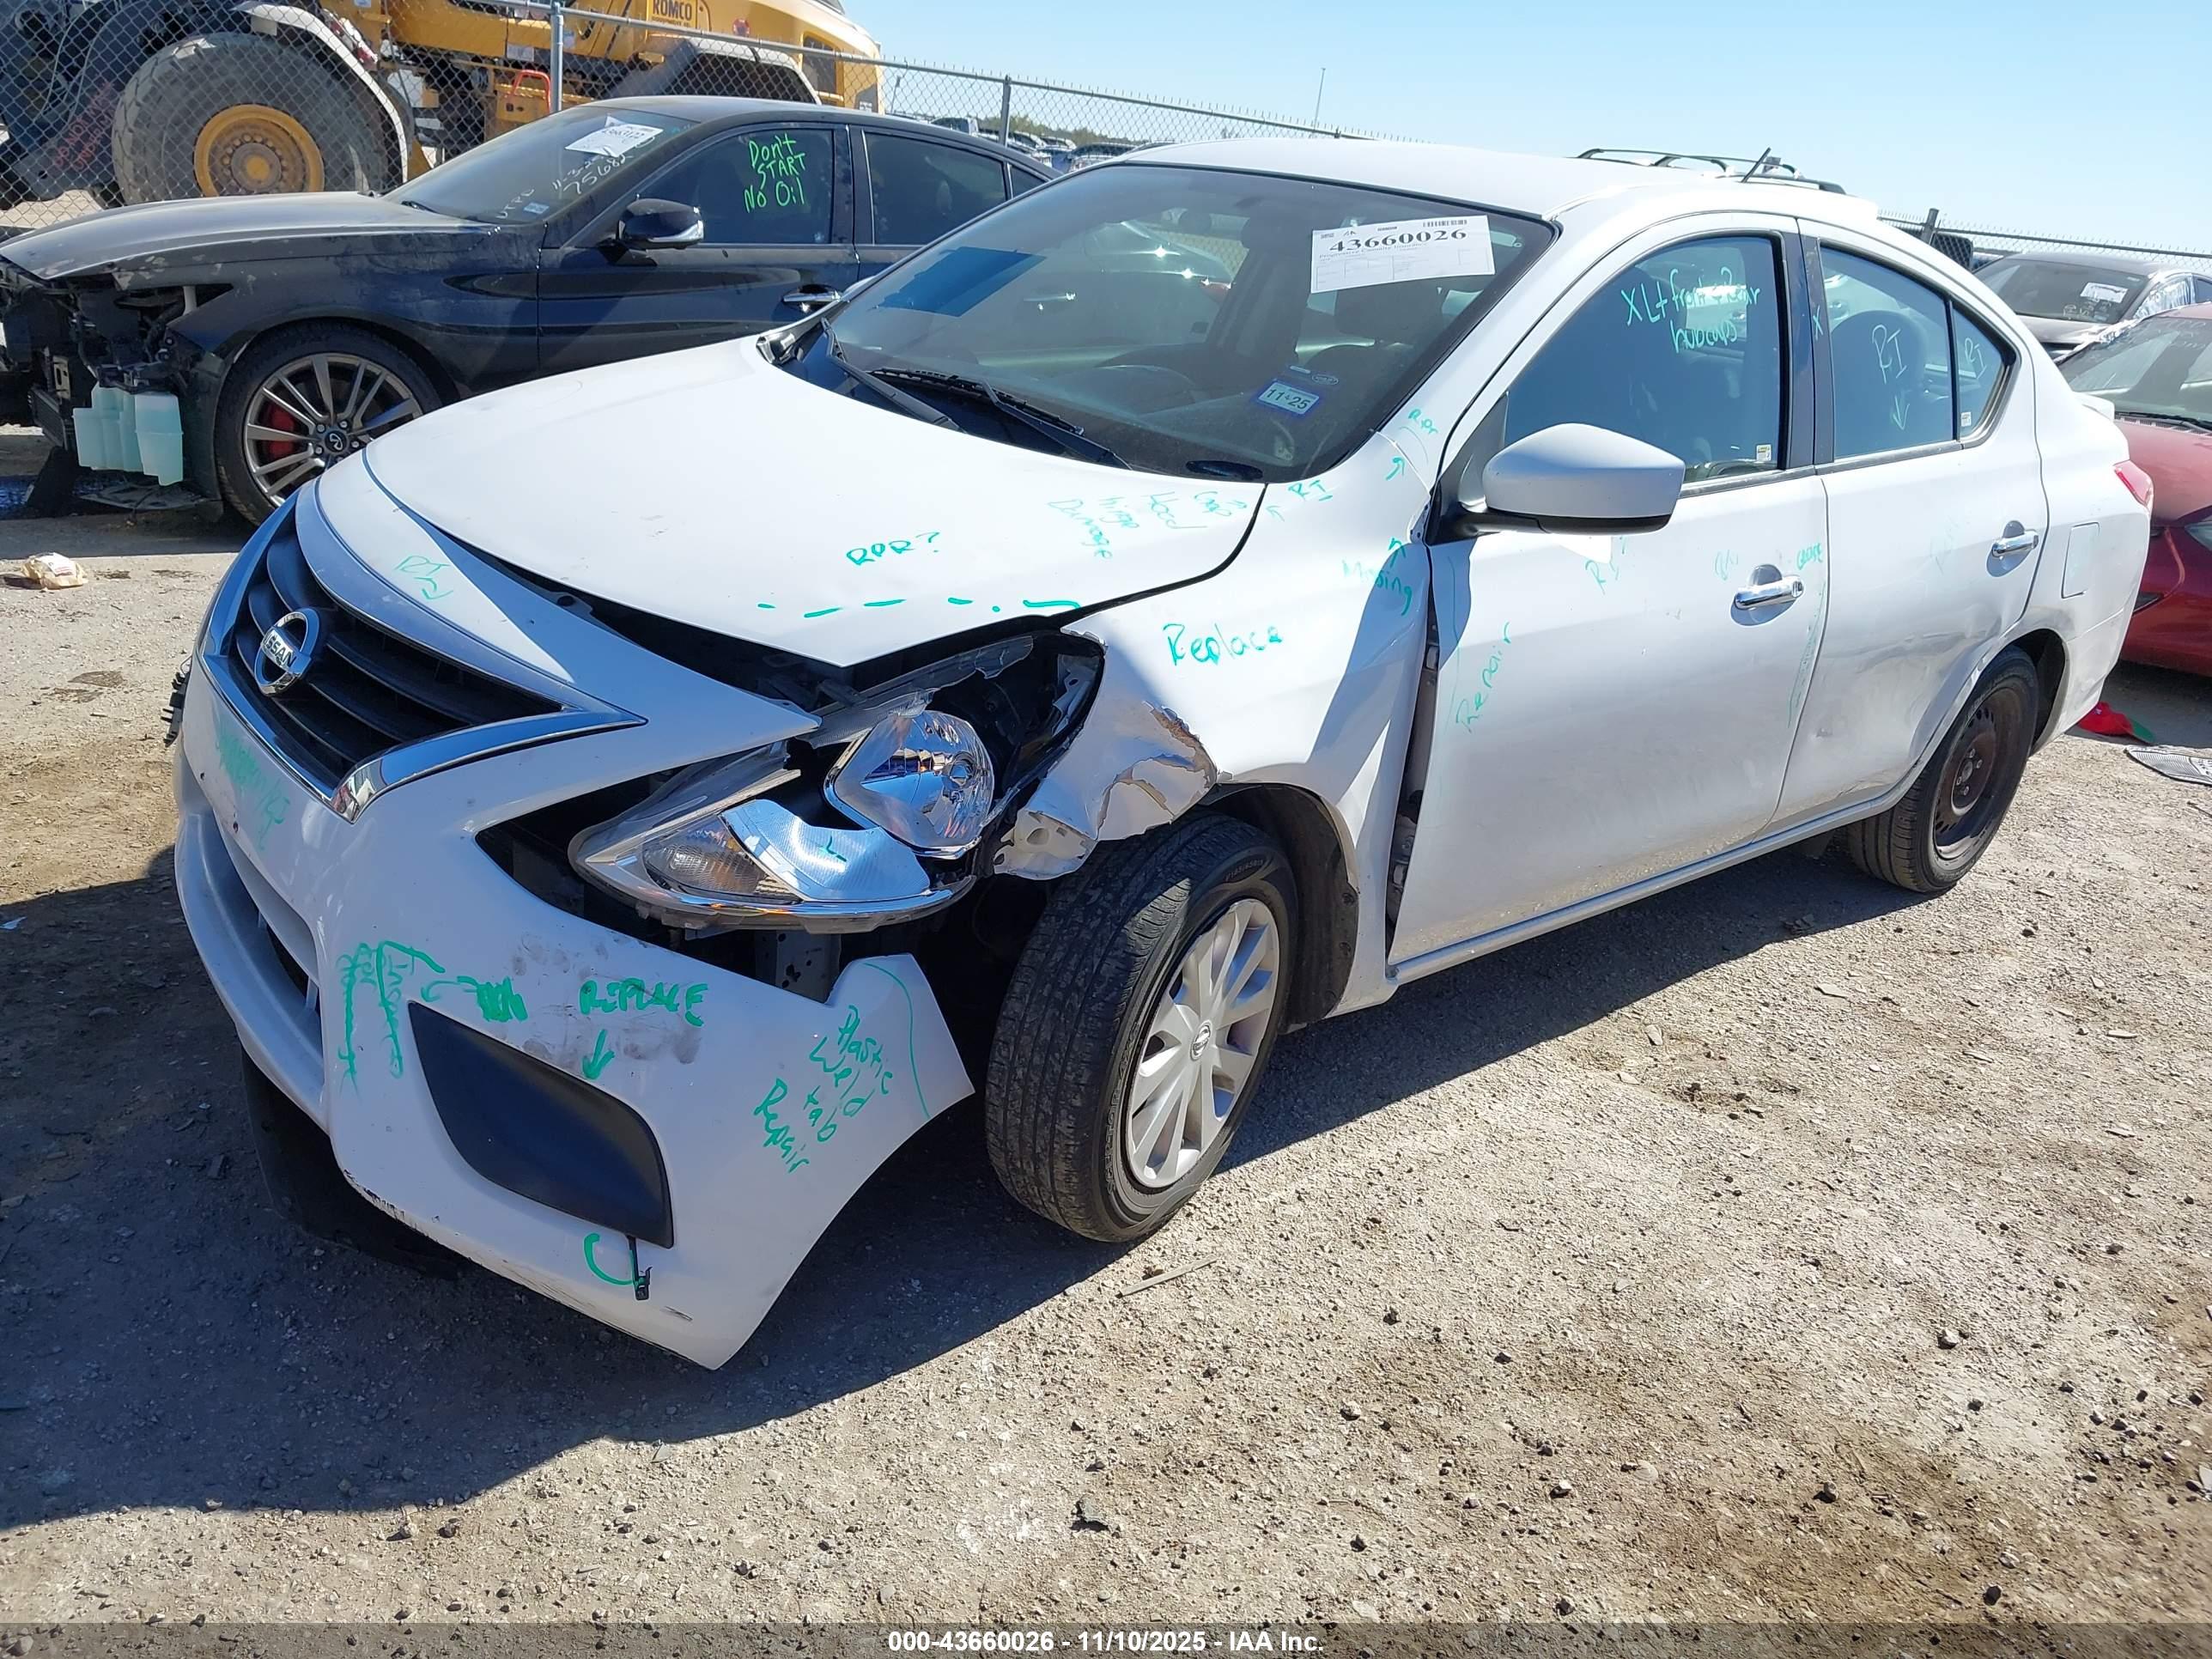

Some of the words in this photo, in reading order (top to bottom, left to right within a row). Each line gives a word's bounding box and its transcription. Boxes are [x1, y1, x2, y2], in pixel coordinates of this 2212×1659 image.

[653, 0, 692, 21] ROMCO
[749, 132, 797, 169] Don't
[757, 153, 805, 190] START
[744, 185, 768, 213] No
[775, 176, 805, 206] Oil
[1330, 228, 1468, 252] 43660026
[1341, 558, 1413, 617] Msing
[263, 629, 298, 668] ISSAN
[1162, 622, 1284, 666] Replace
